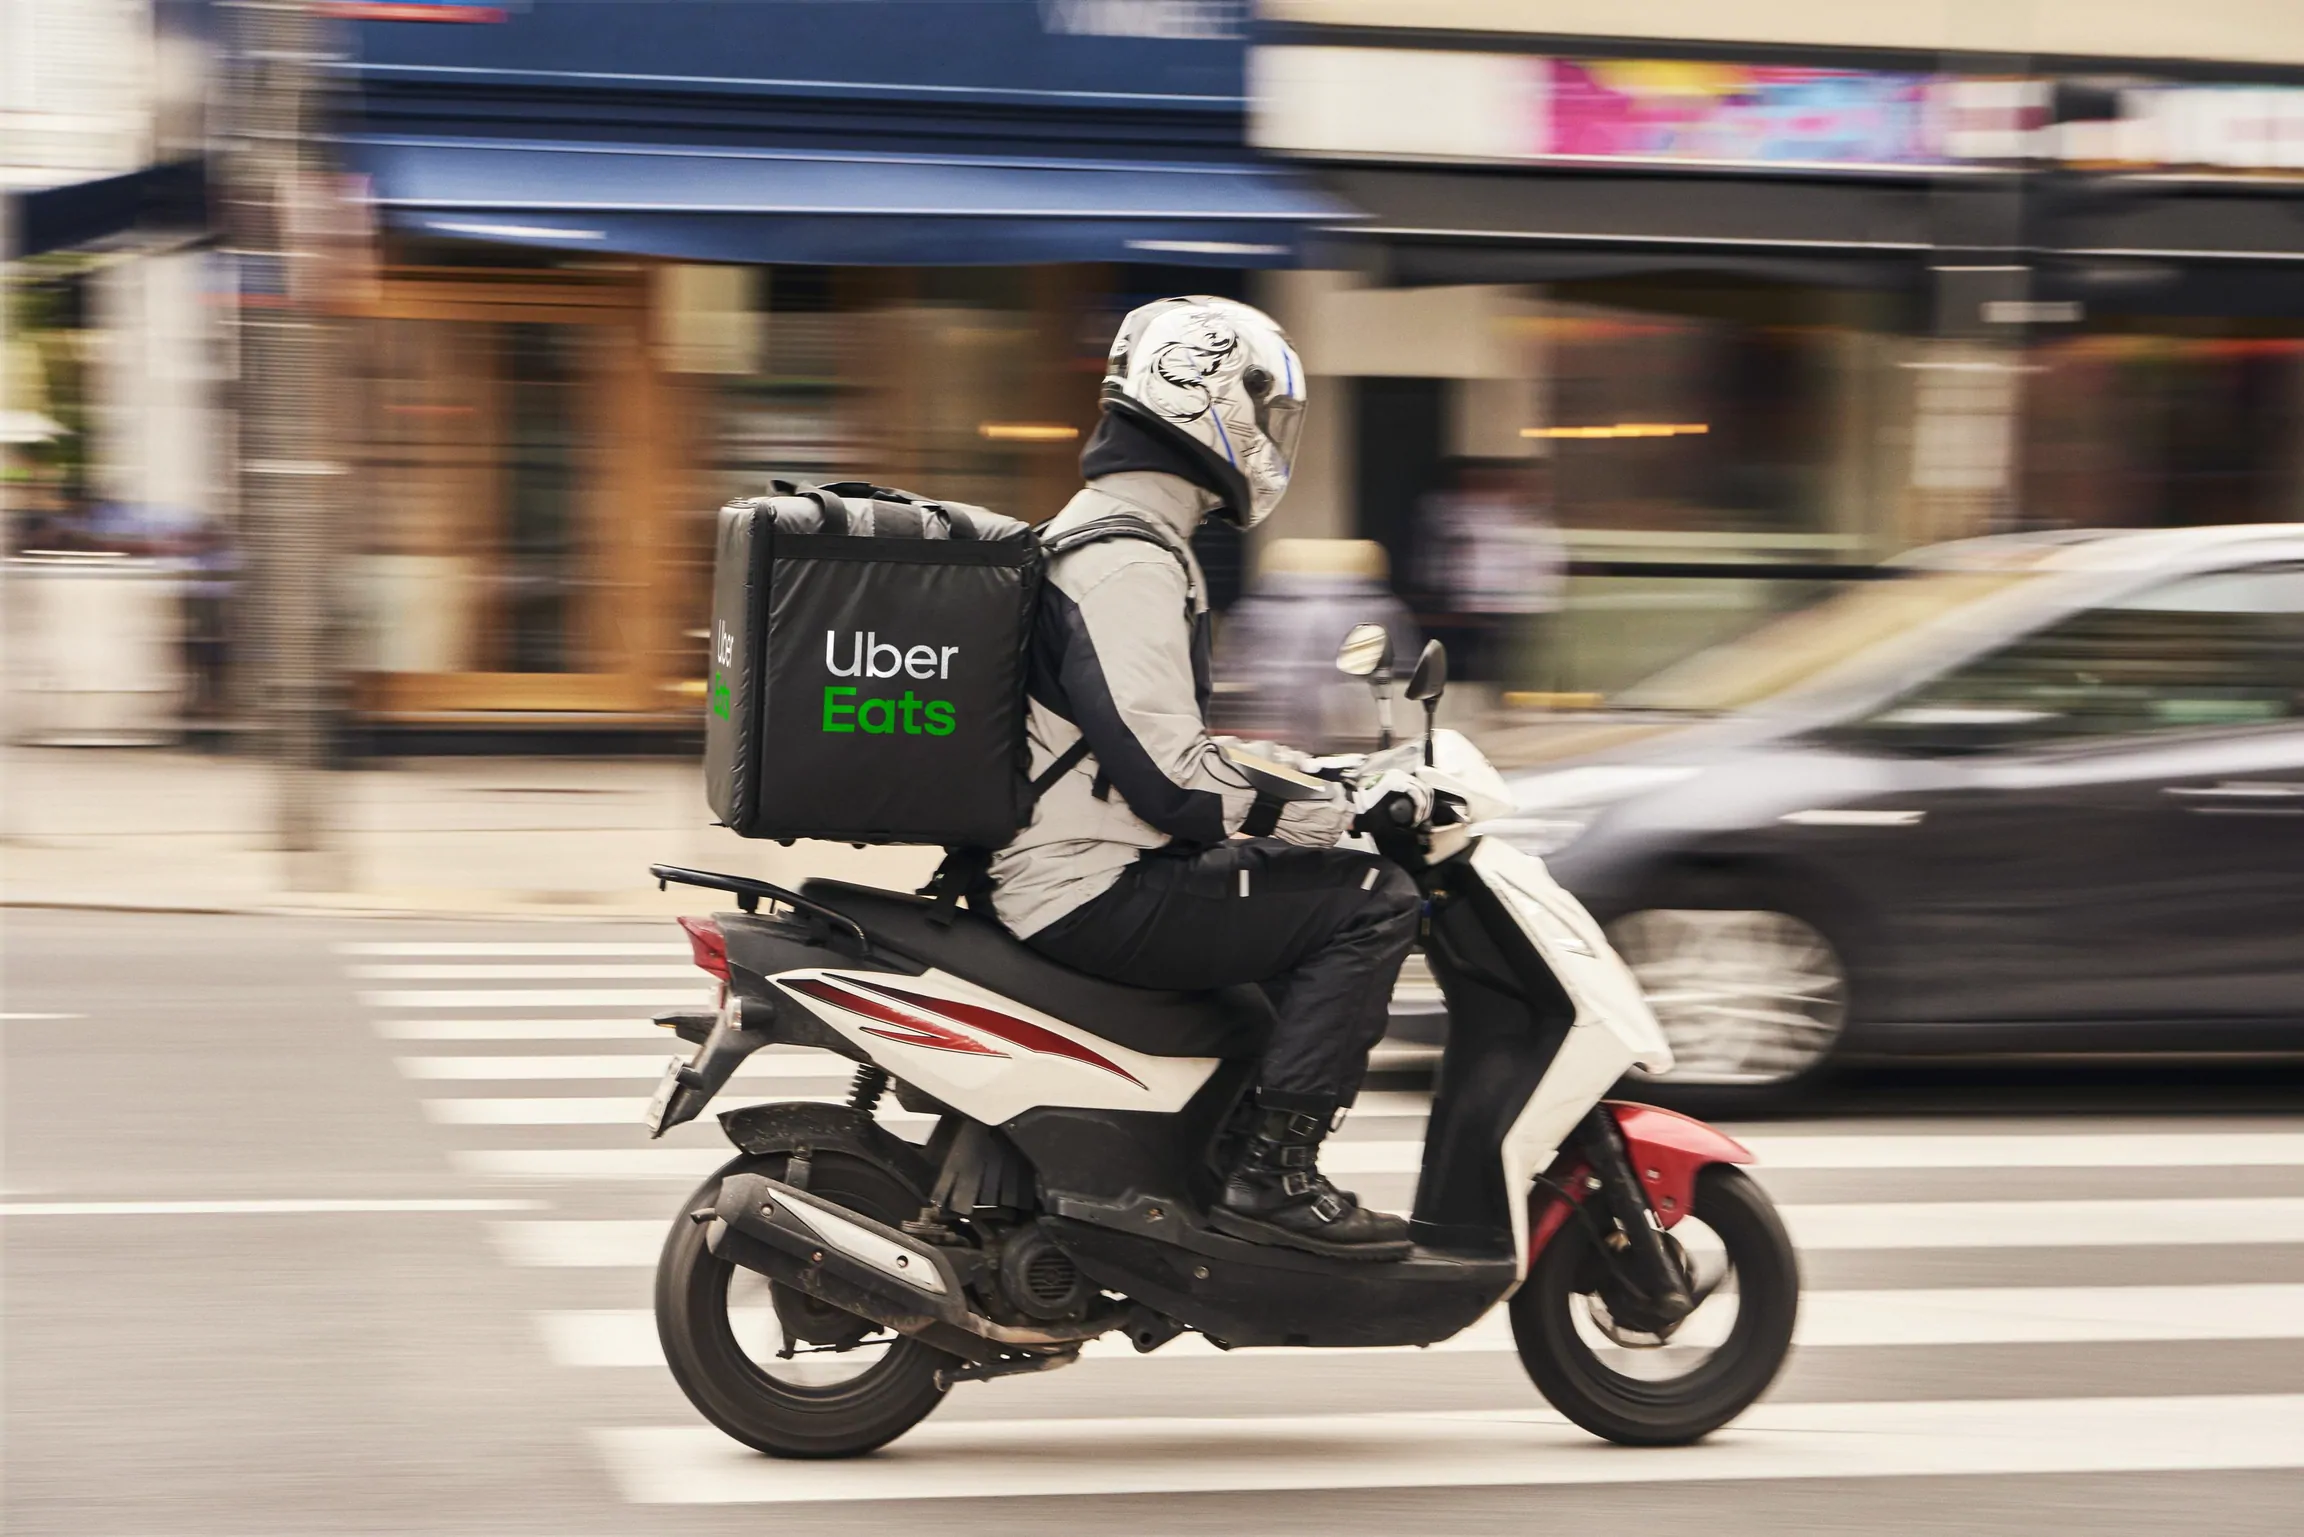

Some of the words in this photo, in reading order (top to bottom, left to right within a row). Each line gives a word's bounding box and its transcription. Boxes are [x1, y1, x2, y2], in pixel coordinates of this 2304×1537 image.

[717, 618, 734, 668] Uber
[826, 630, 959, 680] Uber
[822, 686, 956, 736] Eats
